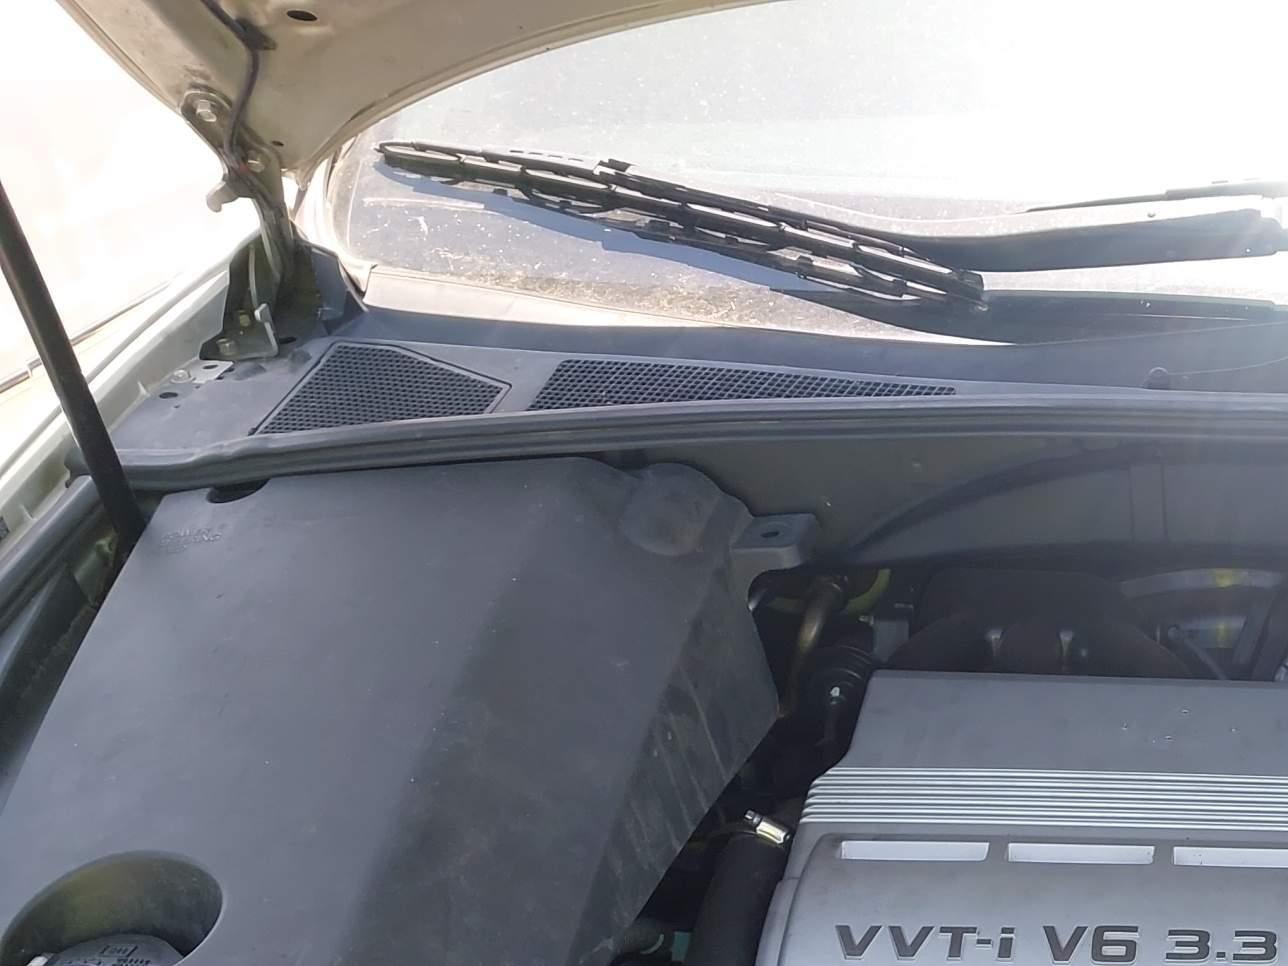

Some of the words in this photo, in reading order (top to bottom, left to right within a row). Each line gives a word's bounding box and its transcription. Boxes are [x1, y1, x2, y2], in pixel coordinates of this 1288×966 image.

[834, 924, 1017, 960] VVT-i
[1042, 925, 1140, 964] V6
[1165, 929, 1279, 962] 3.3
